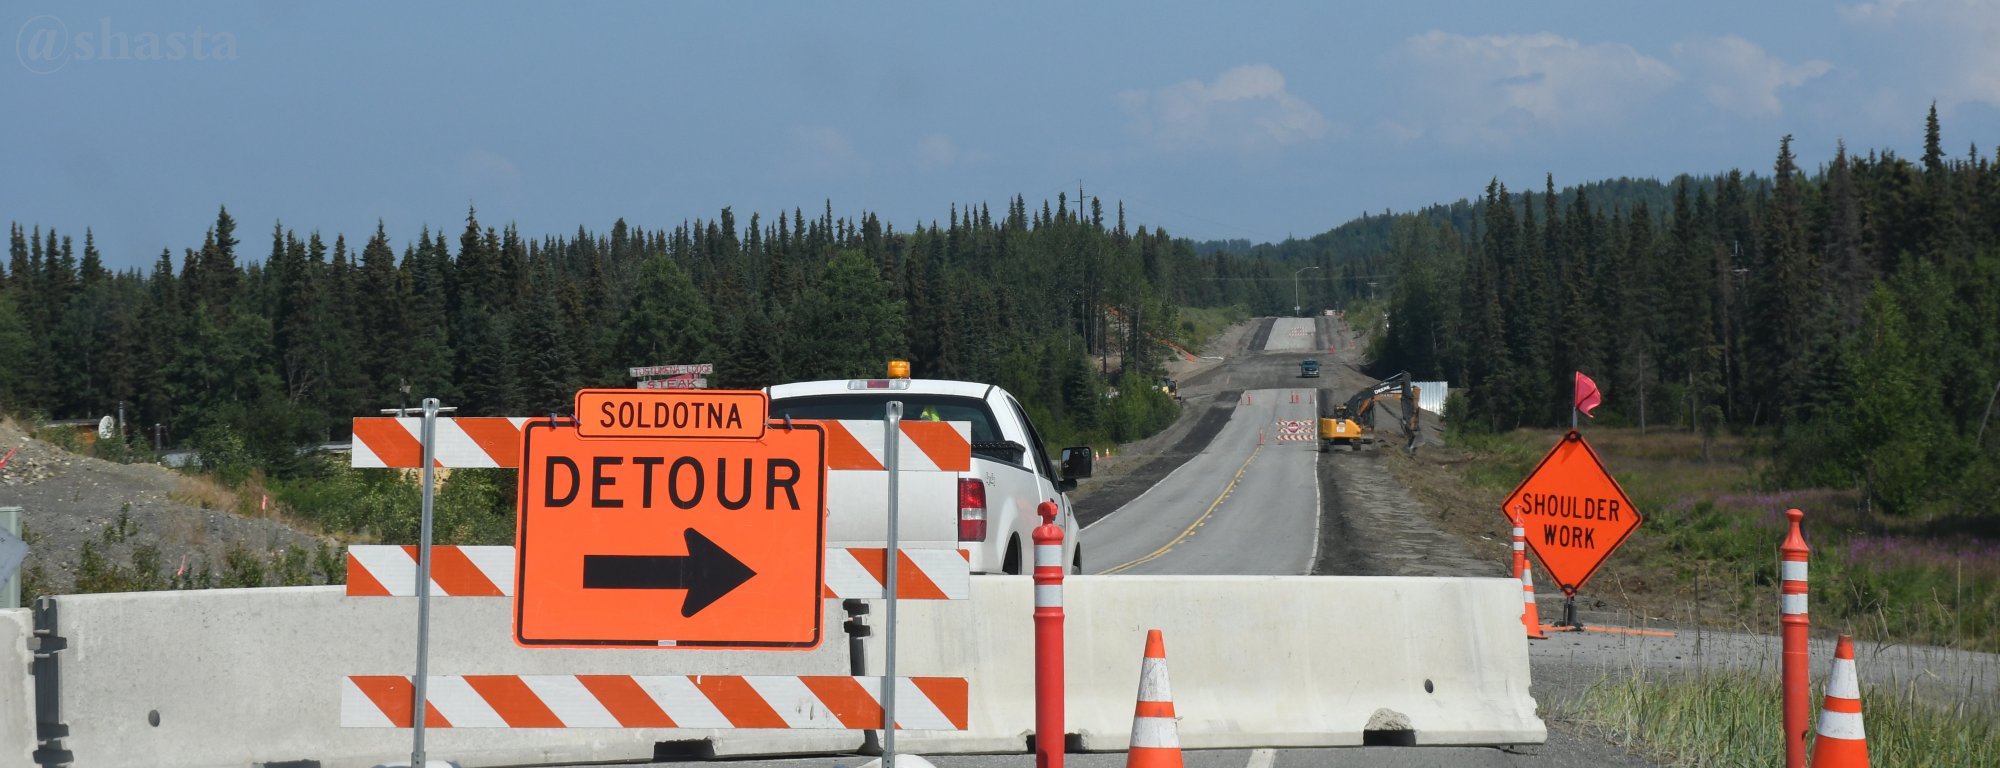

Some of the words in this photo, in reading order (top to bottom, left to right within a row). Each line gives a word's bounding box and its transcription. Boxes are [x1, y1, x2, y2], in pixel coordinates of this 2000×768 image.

[647, 379, 696, 388] STEAK
[600, 401, 742, 429] SOLDOTNA
[544, 455, 801, 510] DETOUR
[1521, 492, 1620, 522] SHOULDER
[1544, 523, 1596, 549] WORK
